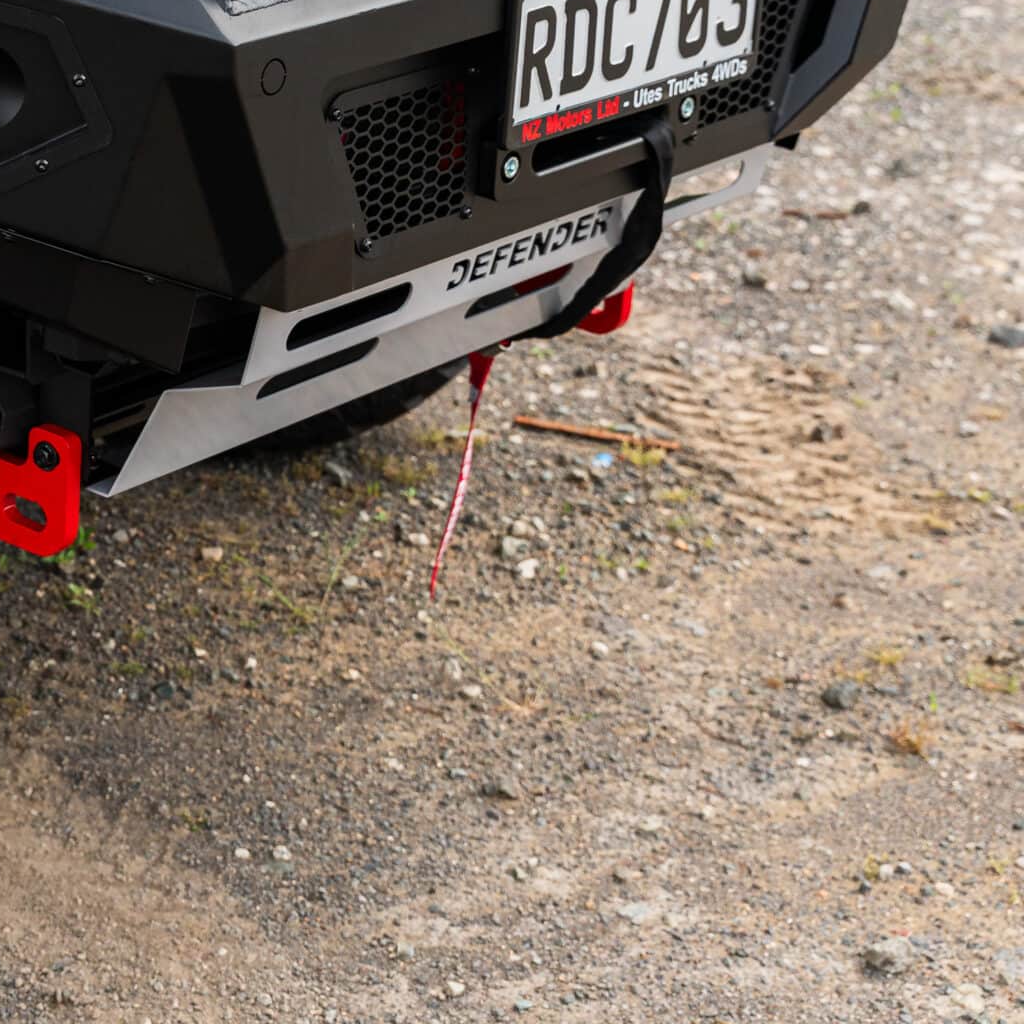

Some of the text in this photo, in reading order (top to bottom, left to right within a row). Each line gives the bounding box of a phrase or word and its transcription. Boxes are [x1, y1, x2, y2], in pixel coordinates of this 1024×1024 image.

[521, 122, 542, 144] NZ
[545, 107, 593, 136] Motors
[596, 96, 620, 120] Ltd
[633, 87, 663, 109] Utes
[667, 71, 709, 97] Trucks
[711, 58, 748, 82] 4WDs
[446, 206, 614, 291] DEFENDER
